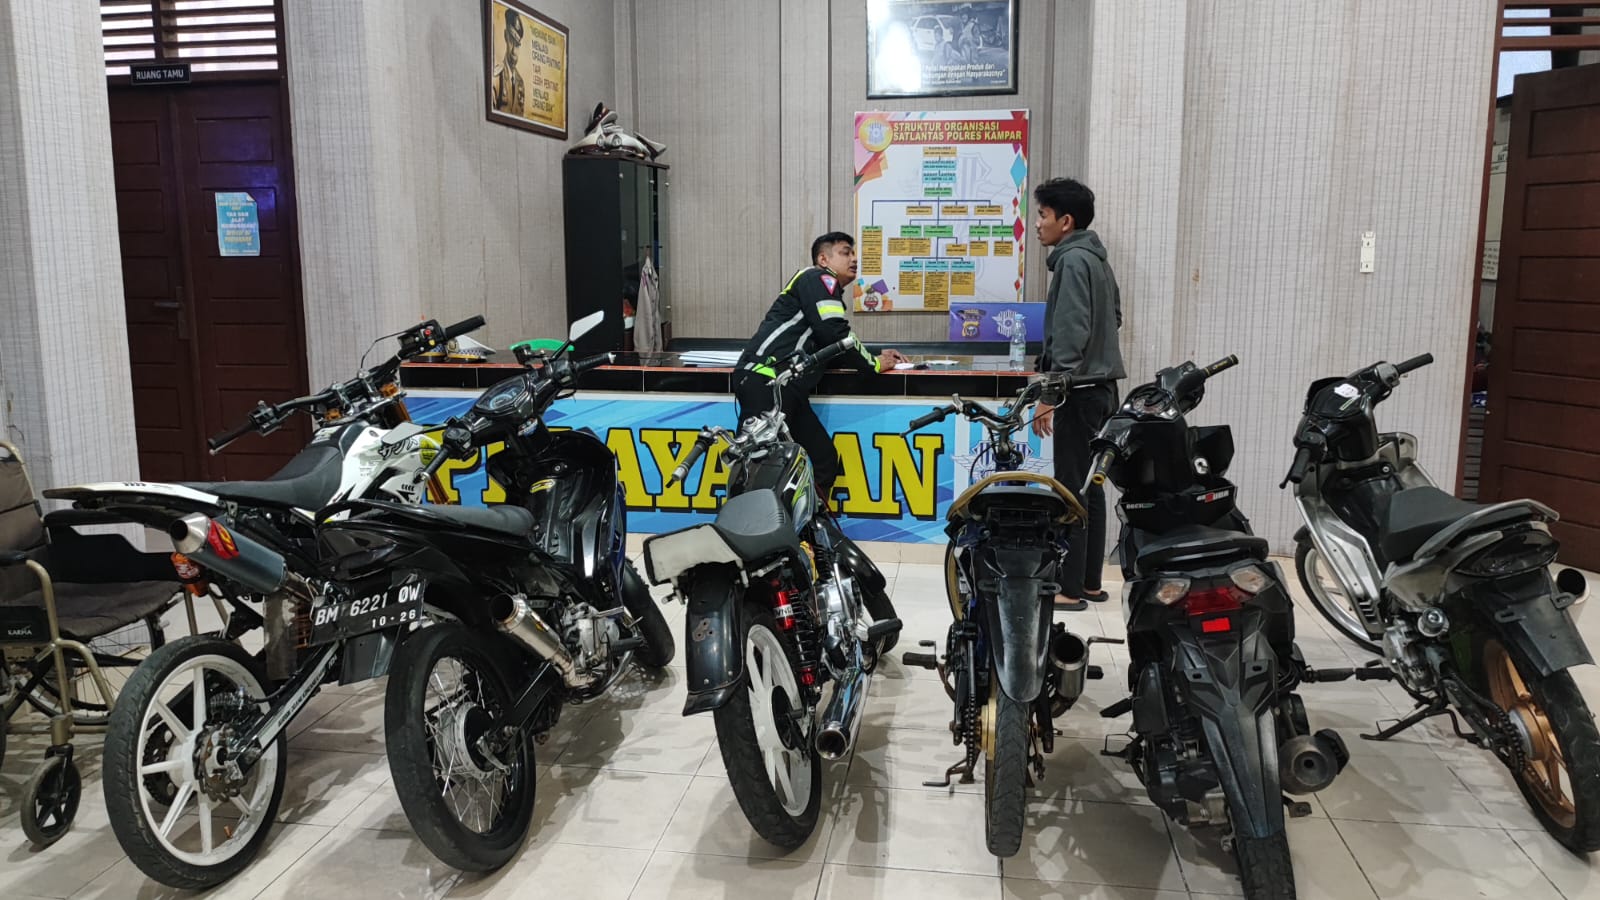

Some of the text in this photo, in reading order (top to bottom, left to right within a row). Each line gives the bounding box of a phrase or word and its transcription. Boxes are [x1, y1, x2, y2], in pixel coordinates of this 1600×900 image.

[136, 69, 184, 80] RUANG TAMU
[893, 121, 1000, 132] STRUKTUR ORGANISASI
[893, 130, 1022, 141] SATLANTAS POLRES KAMPAR
[422, 425, 943, 518] PAYAAN
[315, 606, 339, 625] BM
[350, 592, 388, 616] 6221
